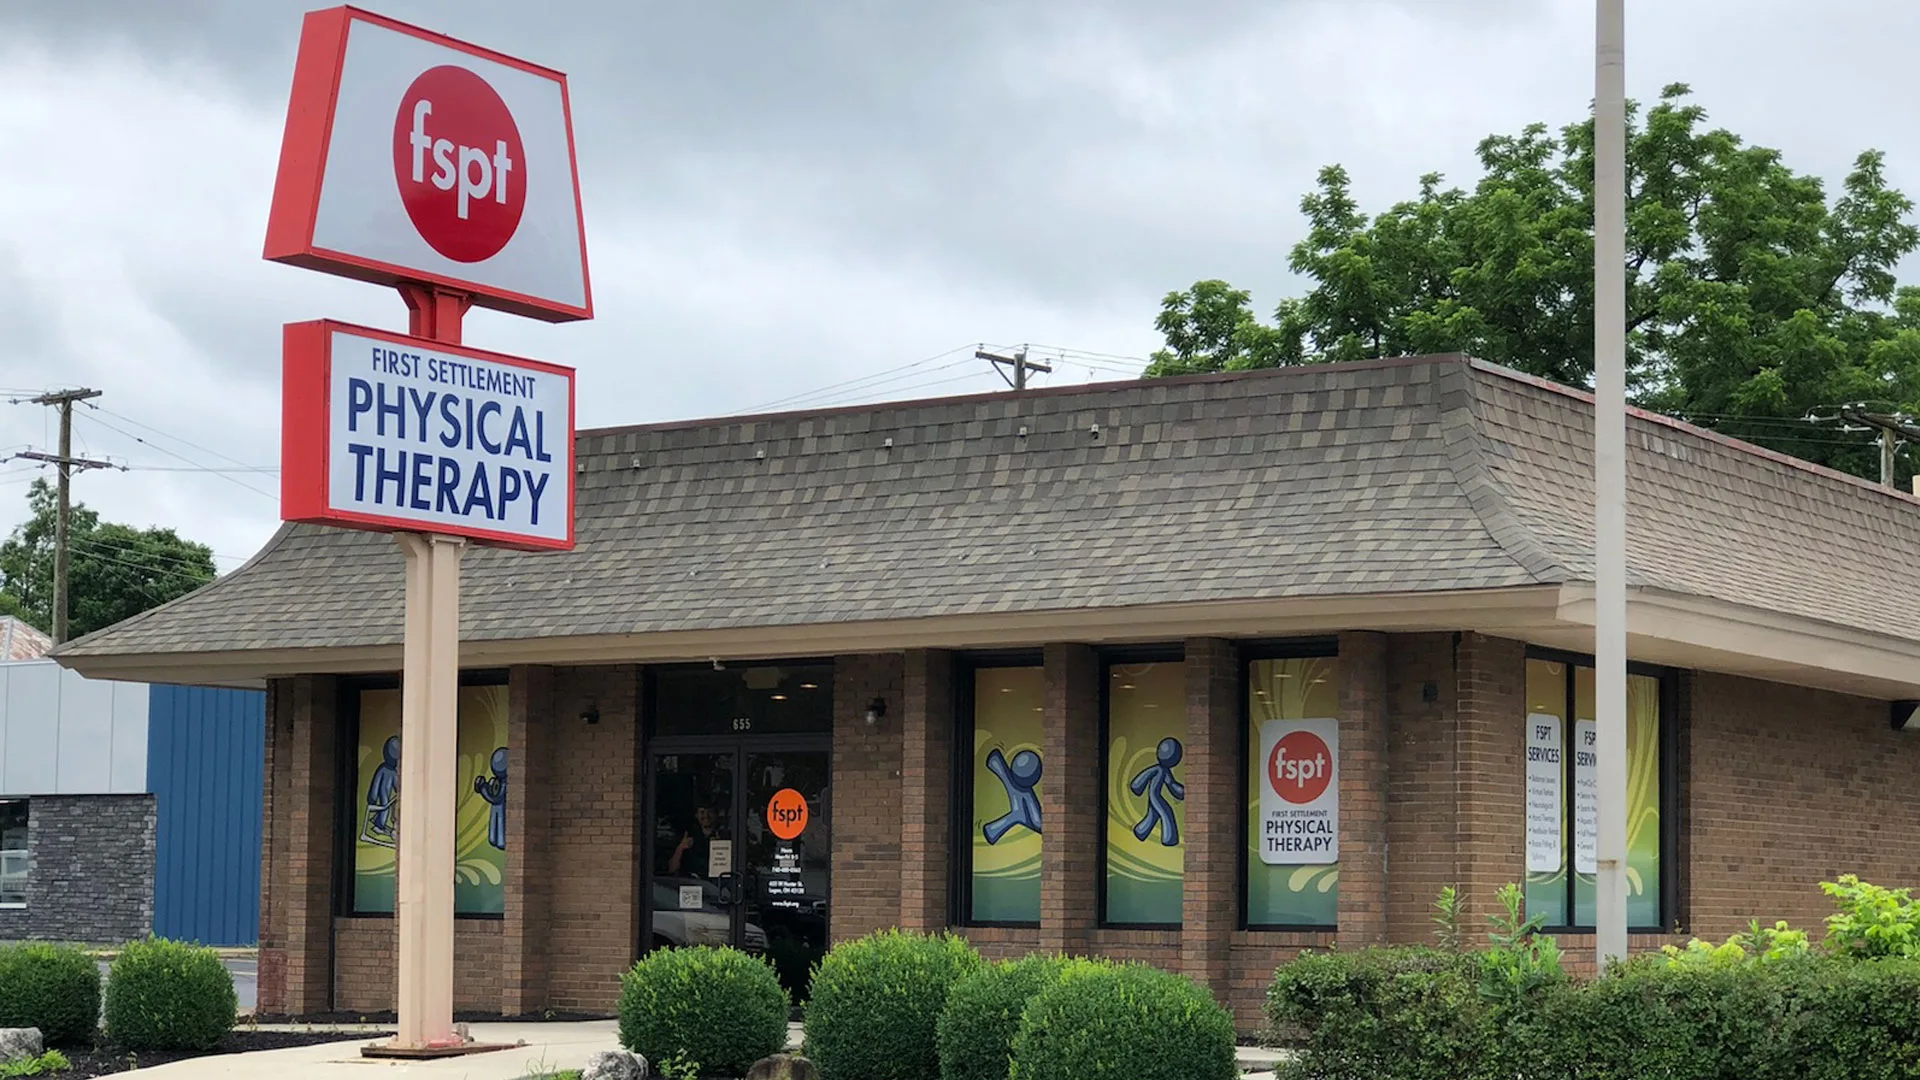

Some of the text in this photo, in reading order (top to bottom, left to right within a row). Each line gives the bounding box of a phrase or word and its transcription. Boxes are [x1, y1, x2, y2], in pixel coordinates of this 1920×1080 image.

[410, 99, 513, 220] fspt
[372, 347, 536, 399] FIRST SETTLEMENT
[348, 376, 552, 463] PHYSICAL
[347, 442, 550, 526] THERAPY
[733, 718, 751, 730] 655
[1536, 725, 1552, 741] FSPT
[1584, 730, 1597, 746] FSP
[1528, 746, 1560, 763] SERVICES
[1275, 747, 1326, 788] fspt
[772, 800, 803, 828] fspt
[1272, 810, 1328, 818] FIRST SETTLEMENT
[1266, 820, 1333, 834] PHYSICAL
[1267, 837, 1332, 851] THERAPY
